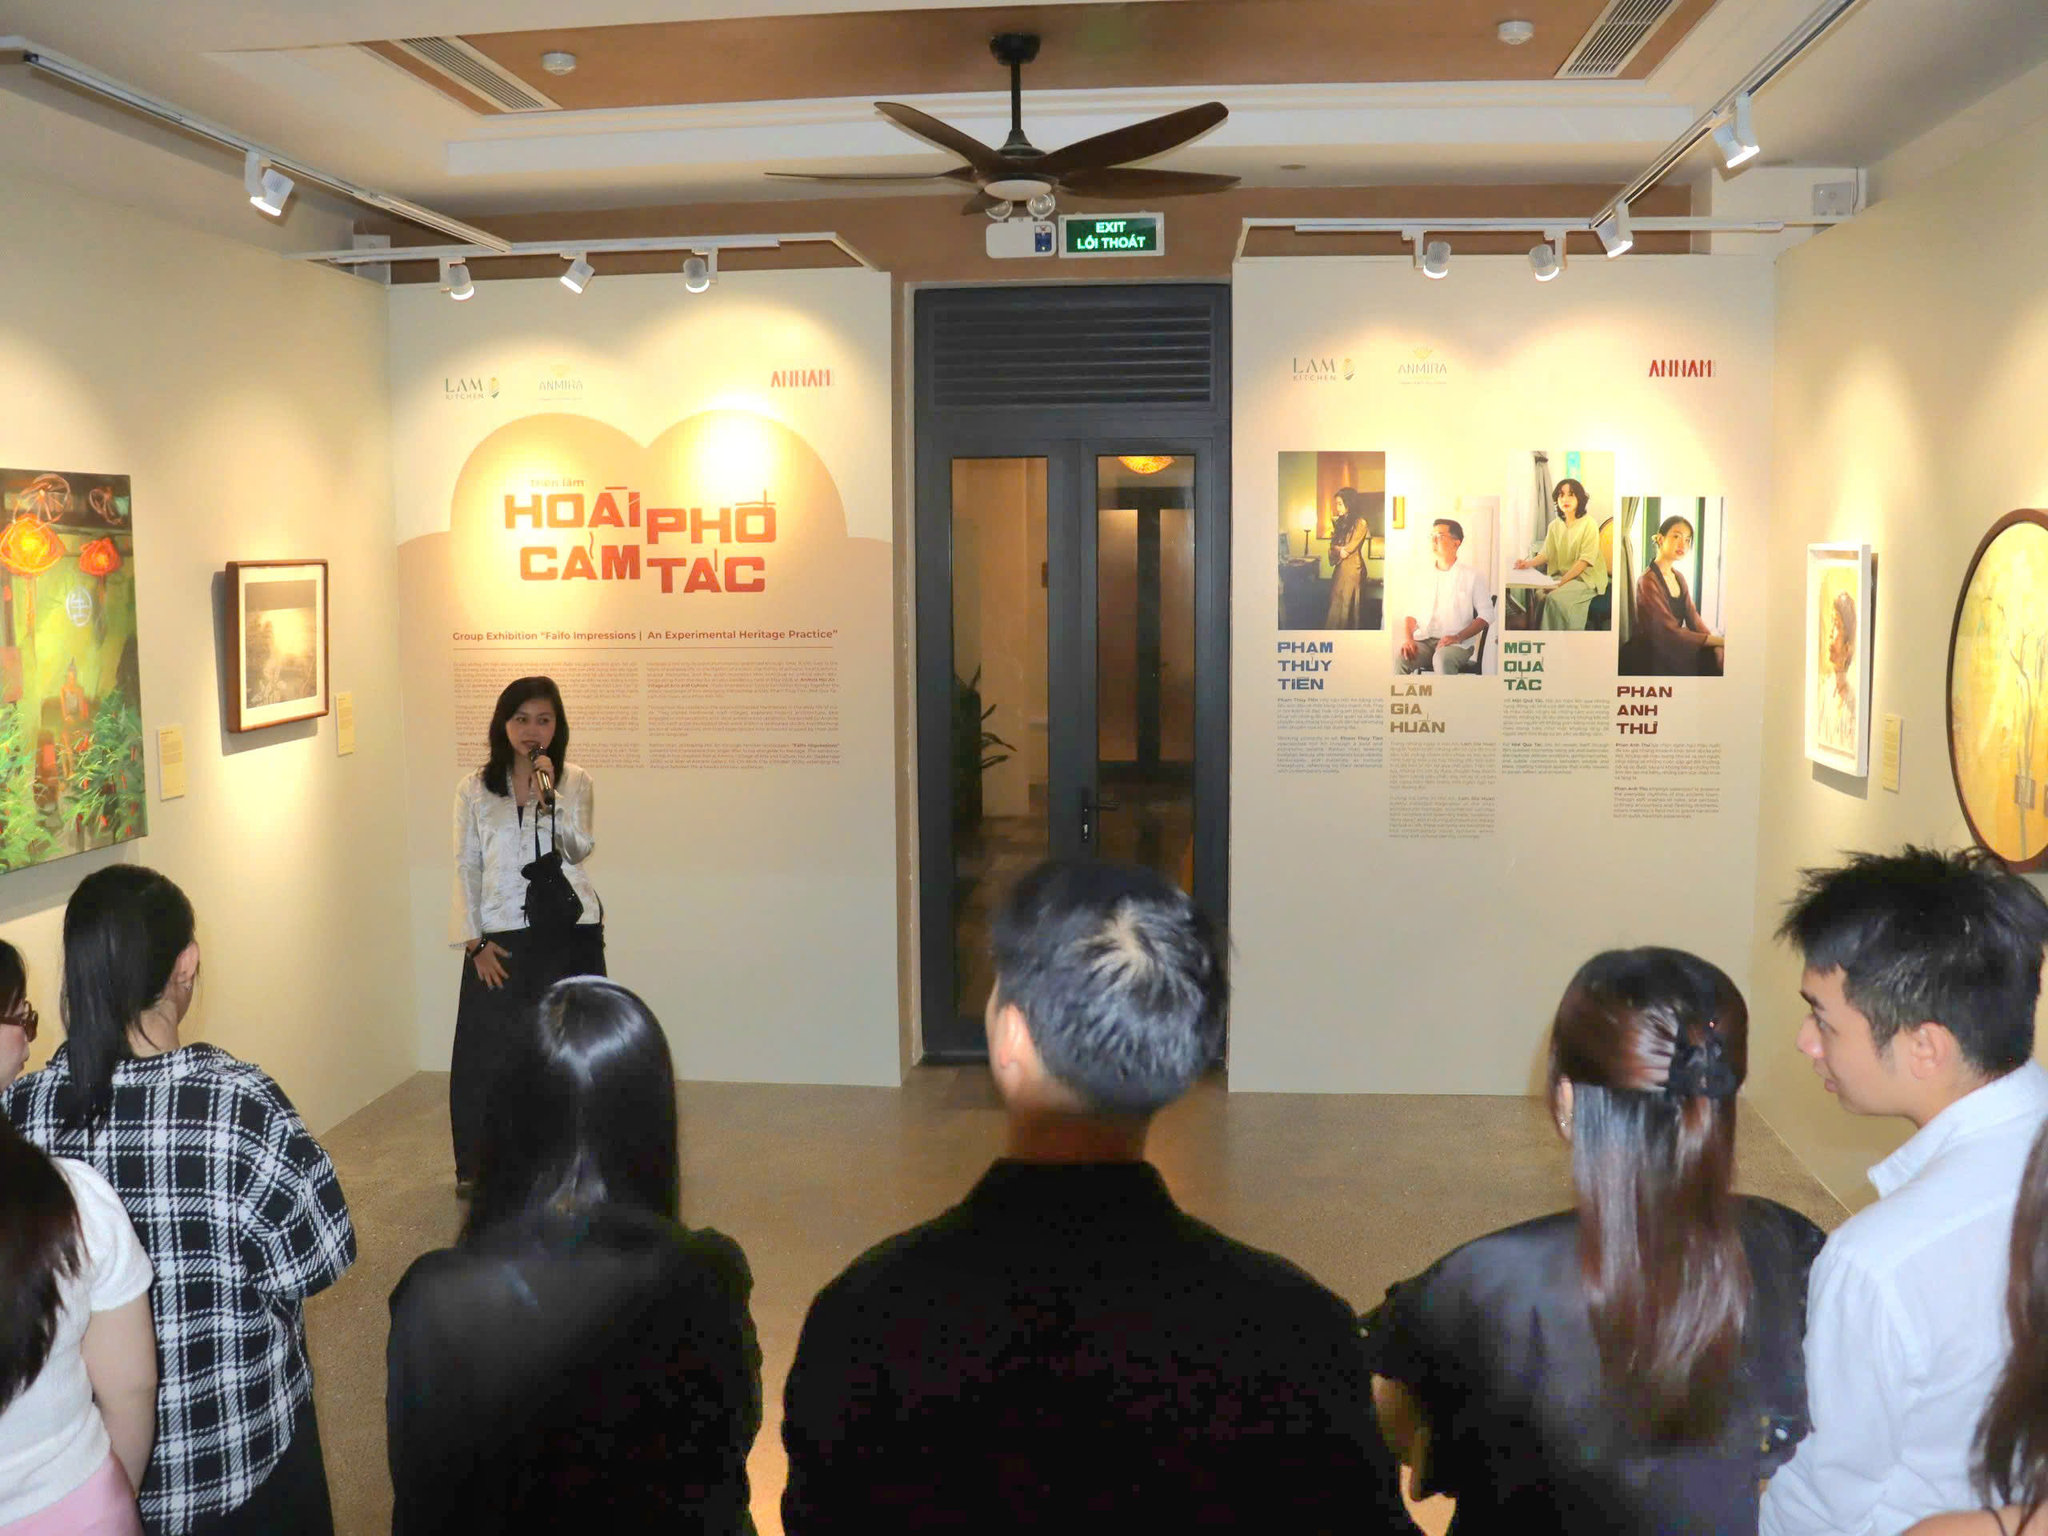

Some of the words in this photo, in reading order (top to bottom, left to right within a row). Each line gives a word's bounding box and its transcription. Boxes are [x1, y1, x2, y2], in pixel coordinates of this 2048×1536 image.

[1096, 221, 1127, 233] EXIT
[1101, 234, 1146, 249] THOÁT
[1293, 357, 1336, 374] LAM
[1398, 362, 1448, 374] ANMIRA
[1648, 359, 1712, 378] ANNAM
[445, 377, 484, 393] LAM
[452, 632, 484, 642] Group
[486, 631, 538, 641] Exhibition
[573, 631, 637, 642] Impressions
[648, 631, 662, 640] An
[665, 630, 736, 642] Experimental
[739, 630, 786, 641] Heritage
[1617, 686, 1673, 697] PHAN
[1390, 703, 1422, 715] GIA
[1617, 705, 1658, 716] ANH
